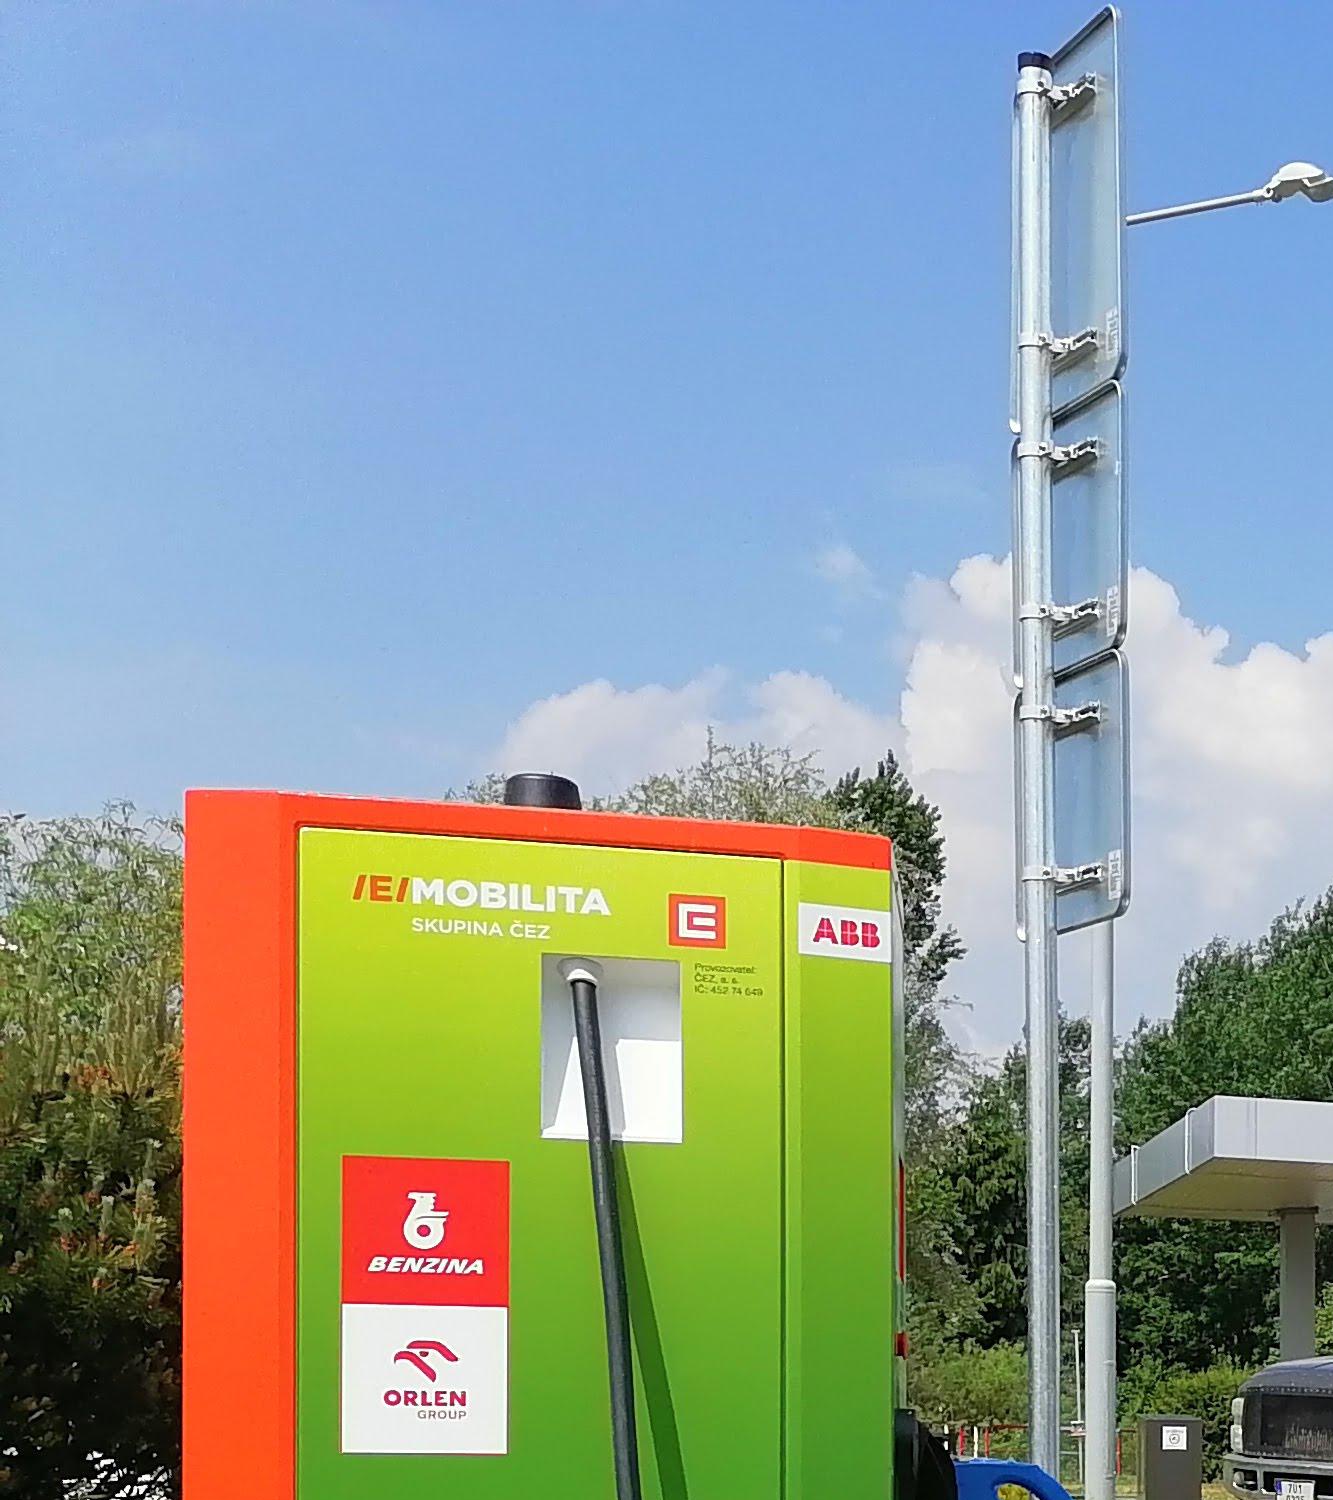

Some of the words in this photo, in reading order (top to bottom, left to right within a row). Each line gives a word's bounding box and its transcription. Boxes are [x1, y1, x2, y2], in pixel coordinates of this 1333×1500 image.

[411, 917, 503, 938] SKUPINA
[509, 919, 550, 939] ČEZ
[813, 917, 880, 948] ABB
[368, 1256, 484, 1275] BENZINA
[383, 1389, 467, 1406] ORLEN
[417, 1410, 467, 1420] GROUP
